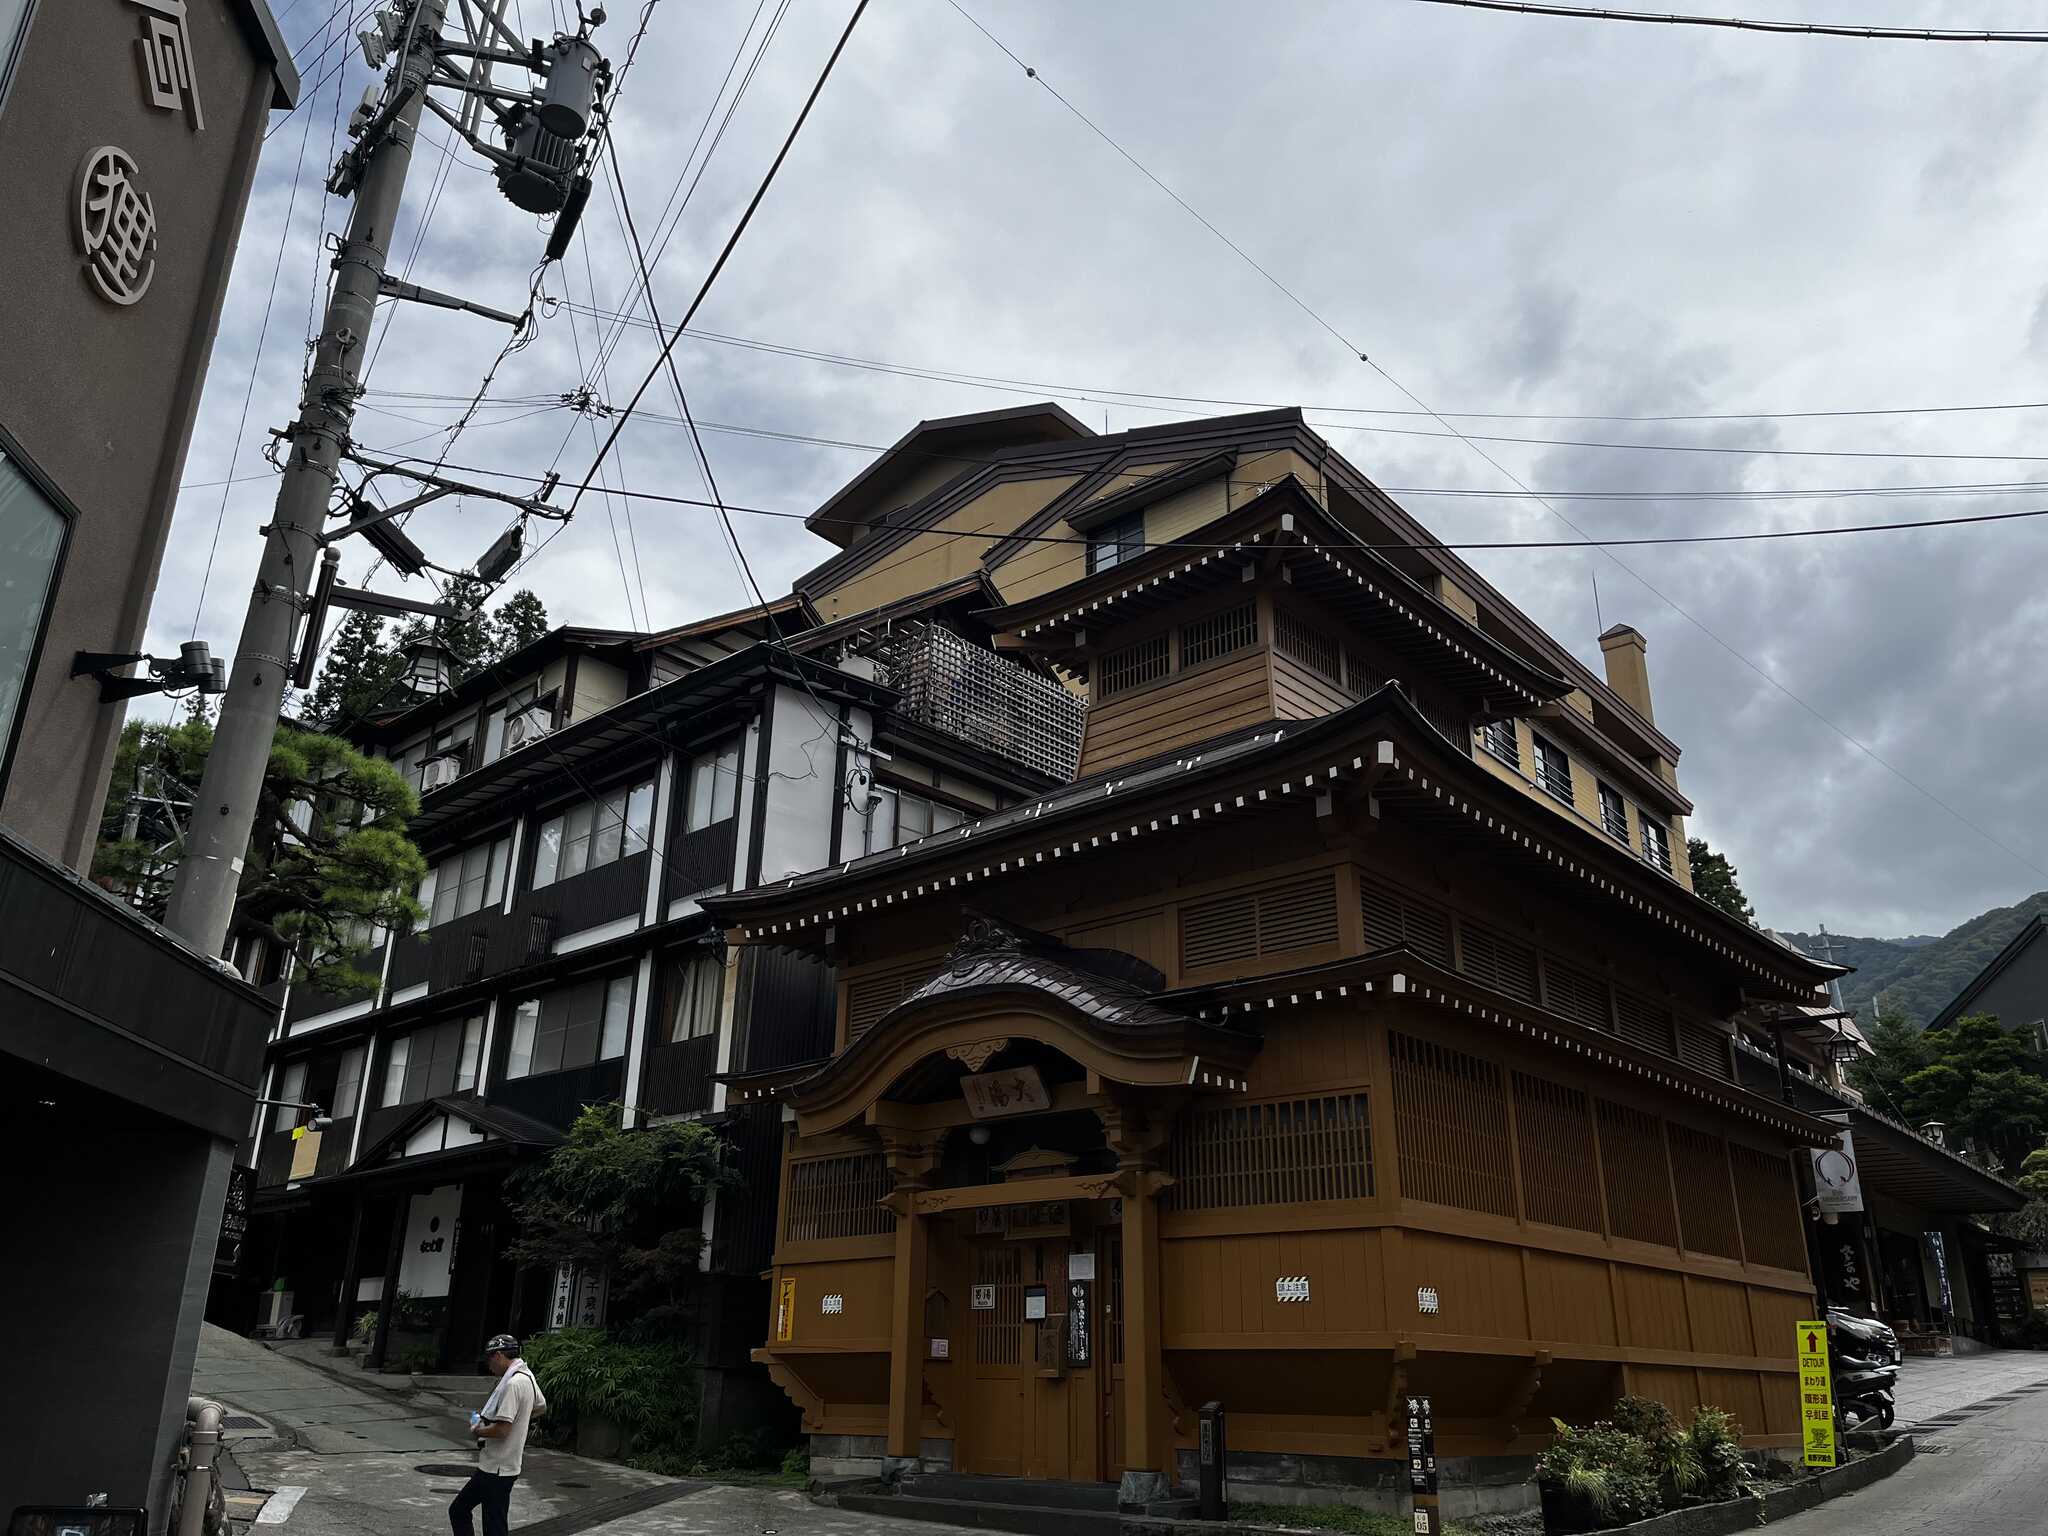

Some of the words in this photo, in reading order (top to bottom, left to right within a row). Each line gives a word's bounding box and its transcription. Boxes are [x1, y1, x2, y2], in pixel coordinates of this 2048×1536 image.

[1802, 1358, 1825, 1368] DETOUR
[1804, 1376, 1826, 1386] まわり道
[1416, 1521, 1427, 1531] 05
